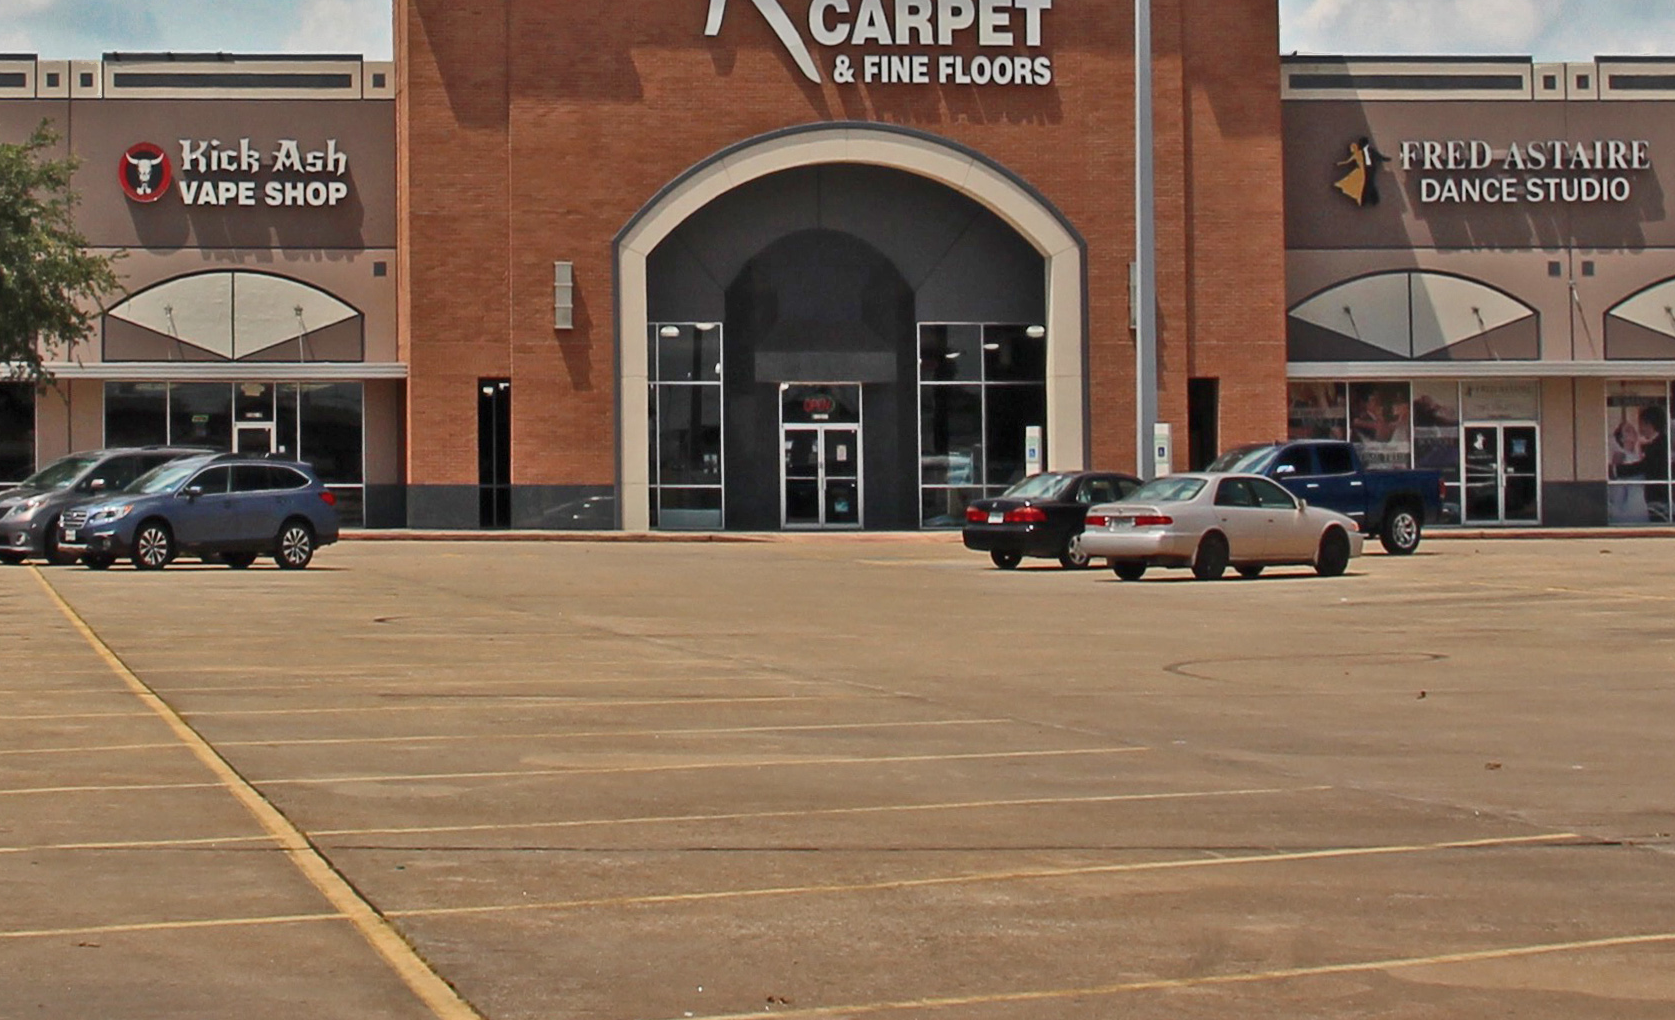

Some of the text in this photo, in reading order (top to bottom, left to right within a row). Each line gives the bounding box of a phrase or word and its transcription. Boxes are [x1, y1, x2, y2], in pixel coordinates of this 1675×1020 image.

[833, 55, 1052, 86] & FINE FLOORS
[179, 138, 347, 176] Kick Ash
[1400, 140, 1651, 170] FRED ASTAIRE
[179, 181, 348, 206] VAPE SHOP
[1421, 177, 1630, 203] DANCE STUDIO
